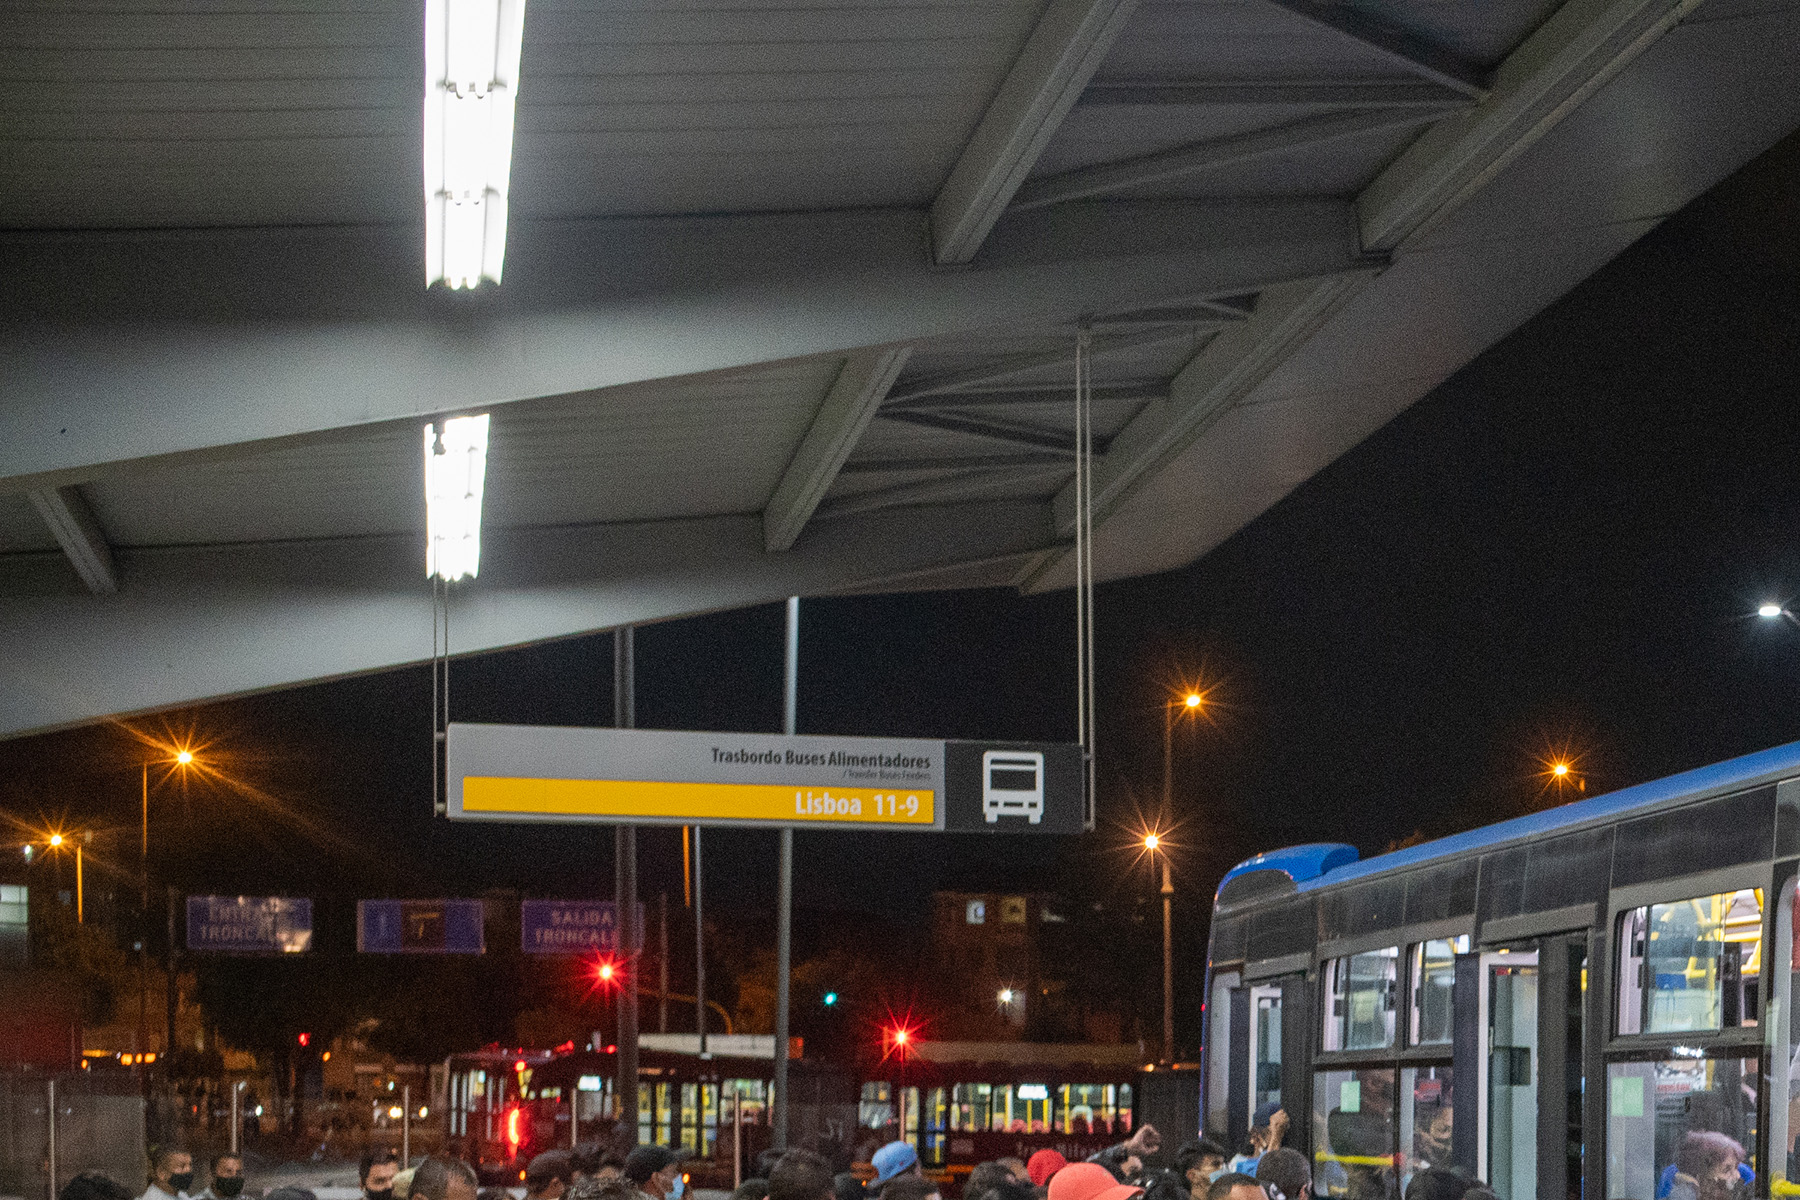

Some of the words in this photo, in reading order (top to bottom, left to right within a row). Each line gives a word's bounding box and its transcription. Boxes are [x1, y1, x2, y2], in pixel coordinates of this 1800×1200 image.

[711, 747, 782, 766] Trasbordo
[785, 750, 826, 766] Buses
[827, 751, 931, 770] Alimentadores
[795, 791, 862, 816] Lisboa
[873, 795, 919, 817] 11-9
[550, 909, 613, 926] SALIDA
[535, 927, 617, 944] TRONCAL
